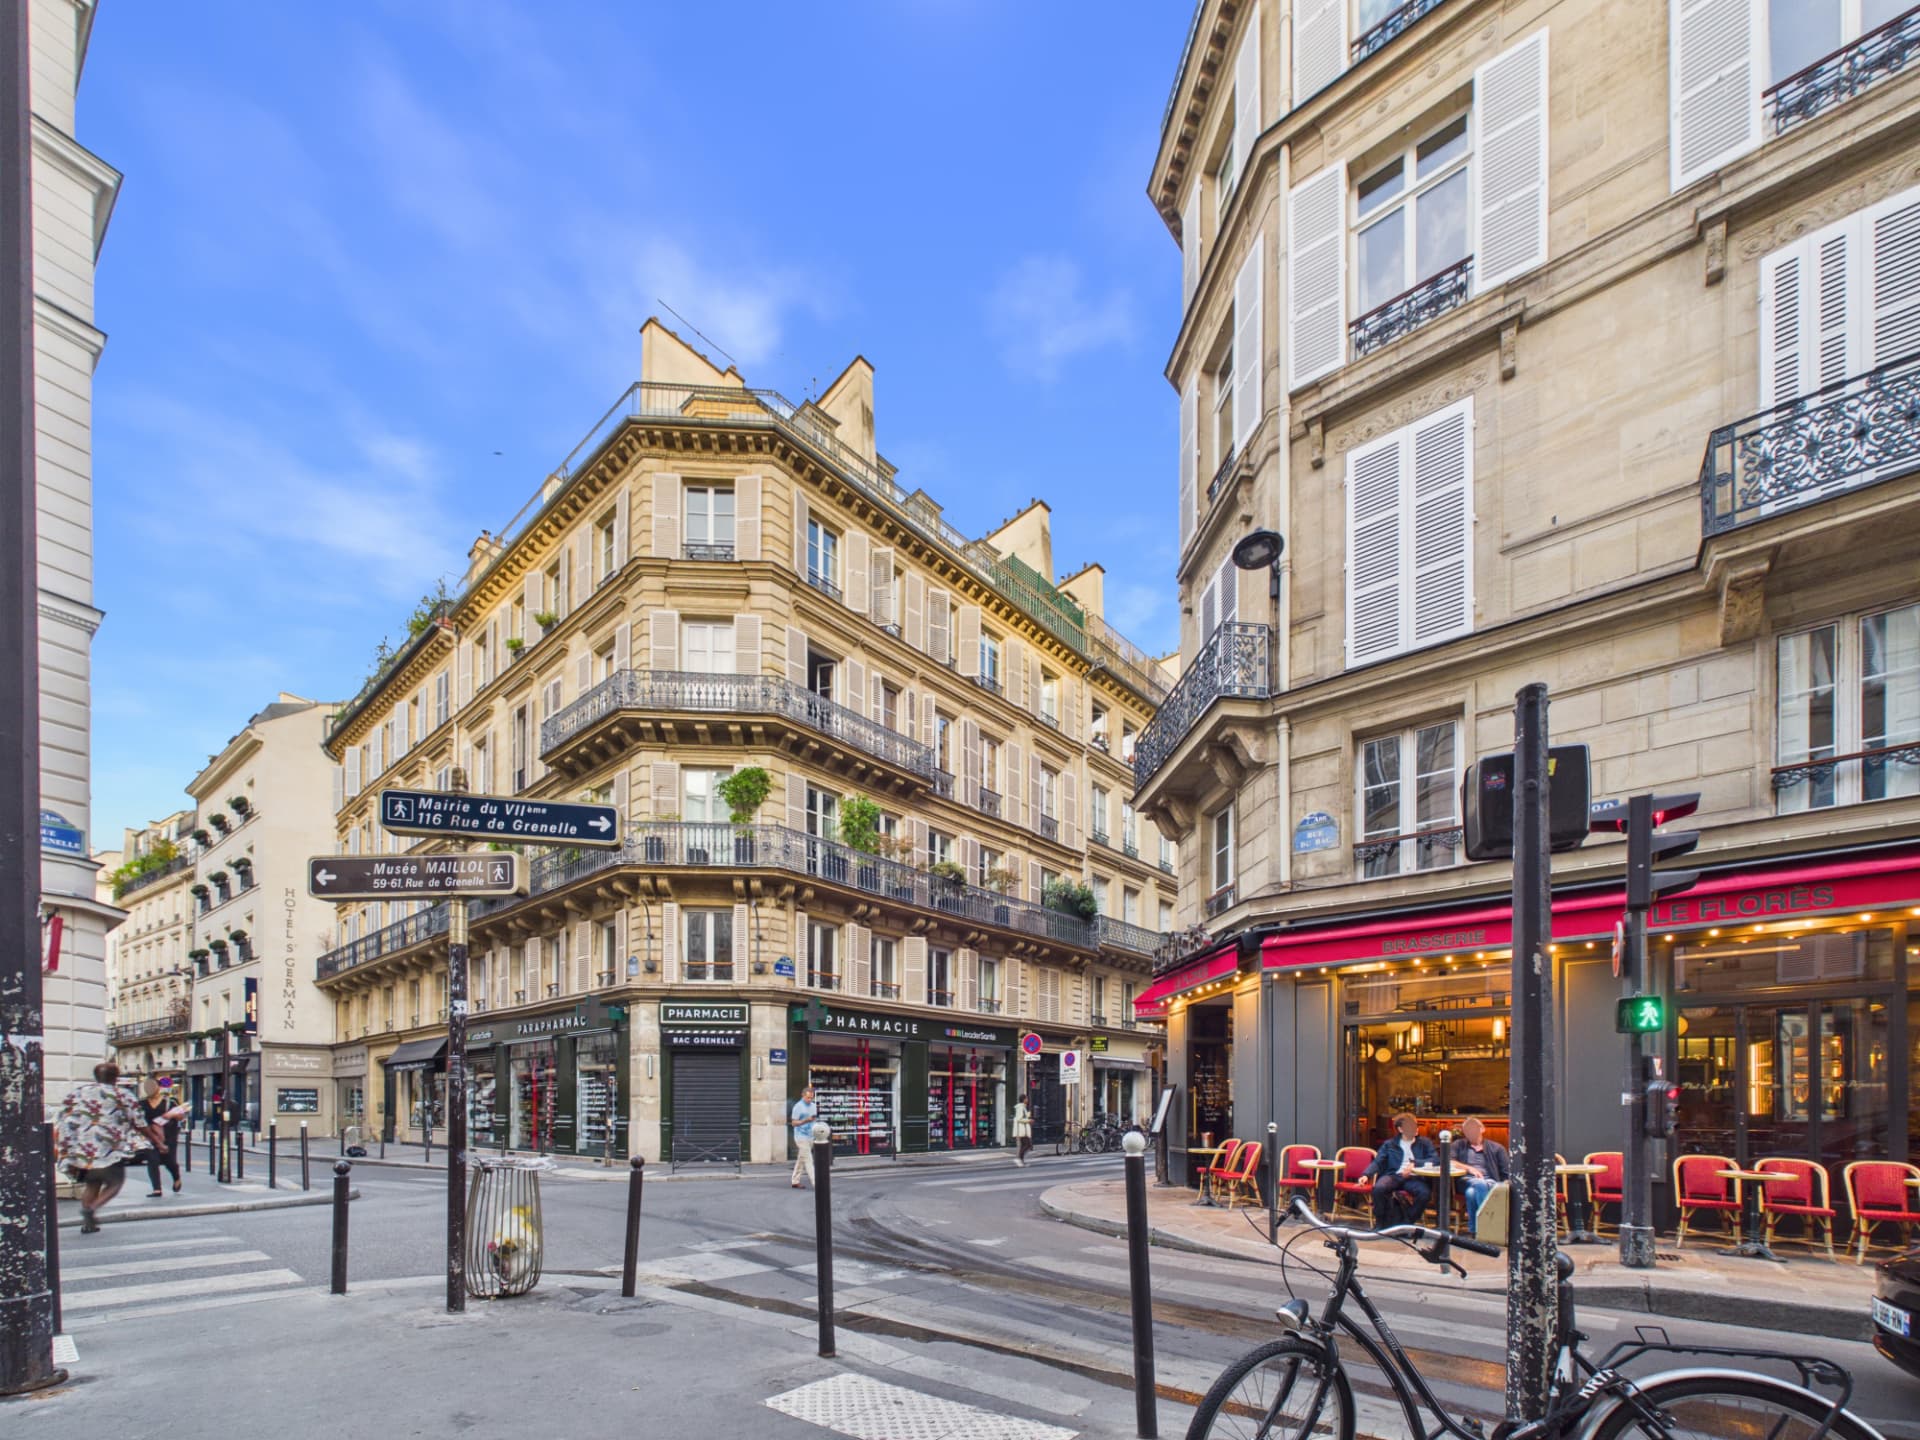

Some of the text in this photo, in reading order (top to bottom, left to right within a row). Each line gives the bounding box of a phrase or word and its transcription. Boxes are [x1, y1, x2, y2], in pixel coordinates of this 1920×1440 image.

[418, 797, 471, 813] Mairie
[480, 802, 498, 814] du
[418, 812, 578, 835] 116 Rue de Grenelle
[373, 860, 485, 875] Musée MAILLOL
[405, 878, 424, 888] Rue
[428, 877, 440, 887] de
[444, 876, 485, 887] Grenelle
[284, 887, 297, 939] HOTEL
[1652, 886, 1834, 924] LE FLORÈS
[1383, 929, 1486, 954] BRASSERIE
[282, 957, 297, 1030] GERMAIN
[668, 1009, 741, 1019] PHARMACIE
[517, 1015, 588, 1035] PARAPHARMAC
[825, 1015, 918, 1034] PHARMACIE
[693, 1037, 735, 1045] GRENELLE
